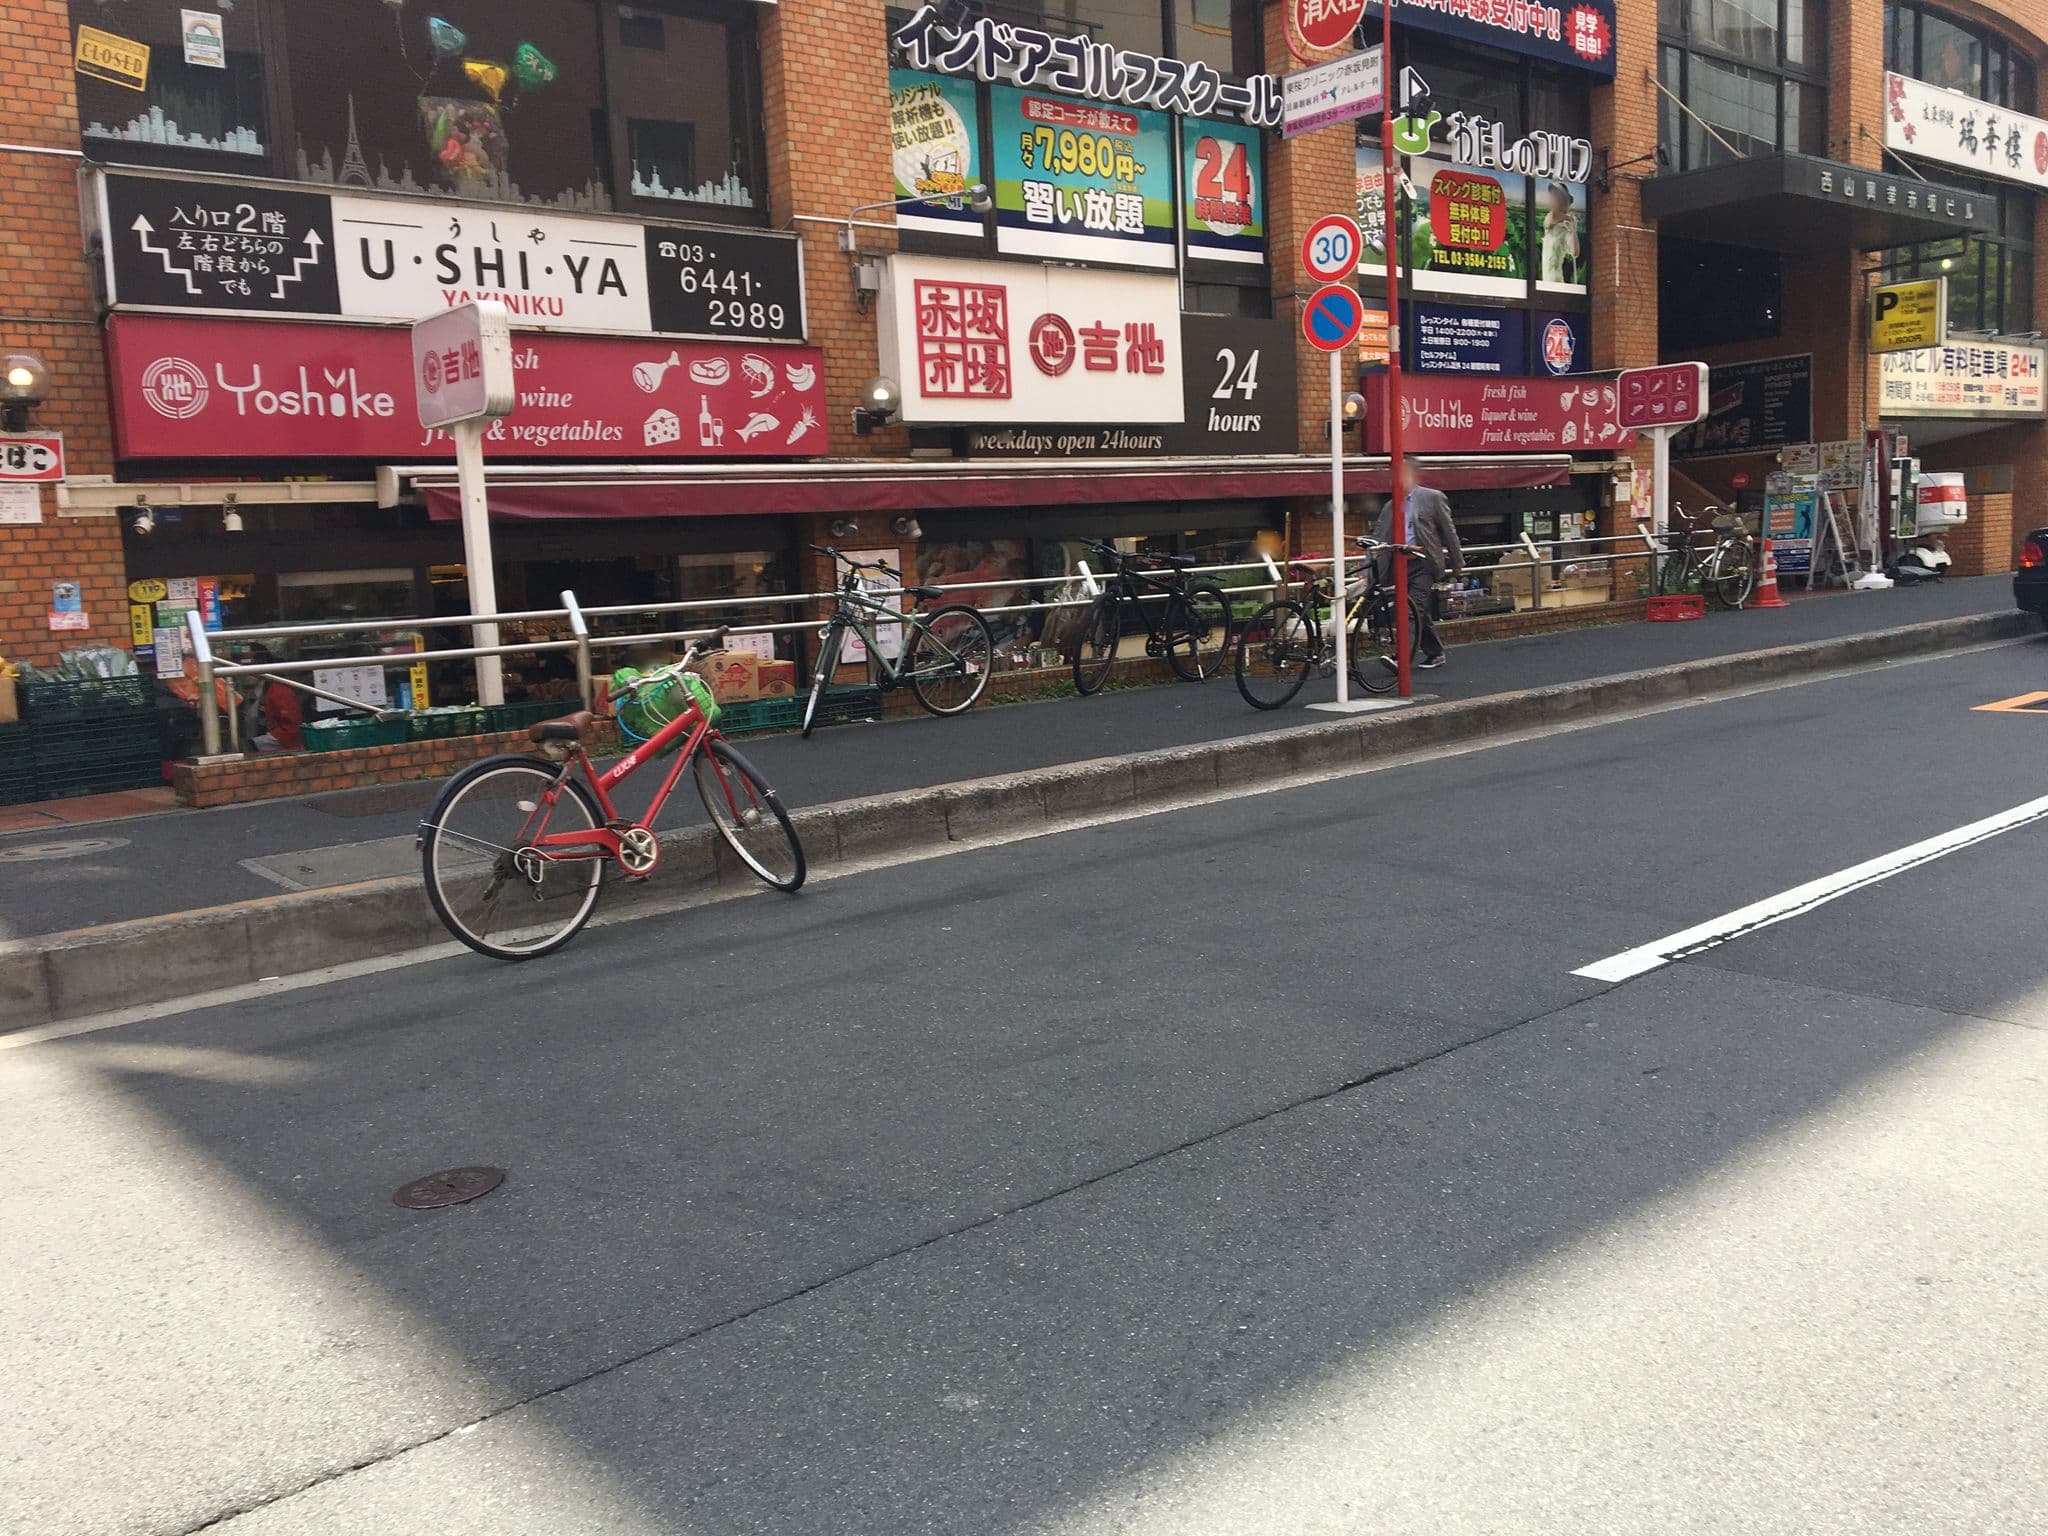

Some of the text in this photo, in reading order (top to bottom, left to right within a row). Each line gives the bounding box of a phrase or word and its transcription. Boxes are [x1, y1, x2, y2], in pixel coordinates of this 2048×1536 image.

[1574, 10, 1598, 32] 見学
[82, 42, 143, 75] CLOSED
[1574, 34, 1603, 55] 自由!
[896, 5, 1284, 126] インドアゴルフスクール
[1028, 100, 1133, 132] 認定コーチが教えて
[1021, 132, 1034, 169] 月々
[1449, 111, 1594, 184] わたしのゴルフ
[1196, 136, 1251, 204] 24
[169, 203, 290, 235] 入り口2階
[1022, 180, 1145, 235] 習い放題
[1449, 201, 1491, 226] 無料体験
[176, 233, 284, 256] 左右どちらの
[1314, 233, 1349, 266] 30
[1450, 223, 1491, 247] 受付中!!
[193, 253, 272, 276] 階段から
[1433, 249, 1450, 264] TEL
[218, 277, 252, 296] でも
[709, 300, 786, 330] 2989
[921, 286, 1003, 338] 赤坂
[1875, 292, 1898, 321] P
[1078, 319, 1166, 375] 吉池
[923, 342, 1008, 395] 市場
[1212, 347, 1261, 401] 24
[2010, 352, 2039, 379] 24H
[216, 361, 396, 417] Yoshike
[520, 386, 573, 408] wine
[1481, 384, 1527, 402] fresh fish
[1207, 408, 1261, 433] hours
[1412, 397, 1474, 430] Yoshike
[1481, 407, 1539, 425] liquor & wine
[486, 418, 507, 442] &
[510, 420, 623, 447] vegetables
[974, 429, 1163, 455] weekdays open 24hours
[1480, 428, 1556, 446] fruit & vegetables
